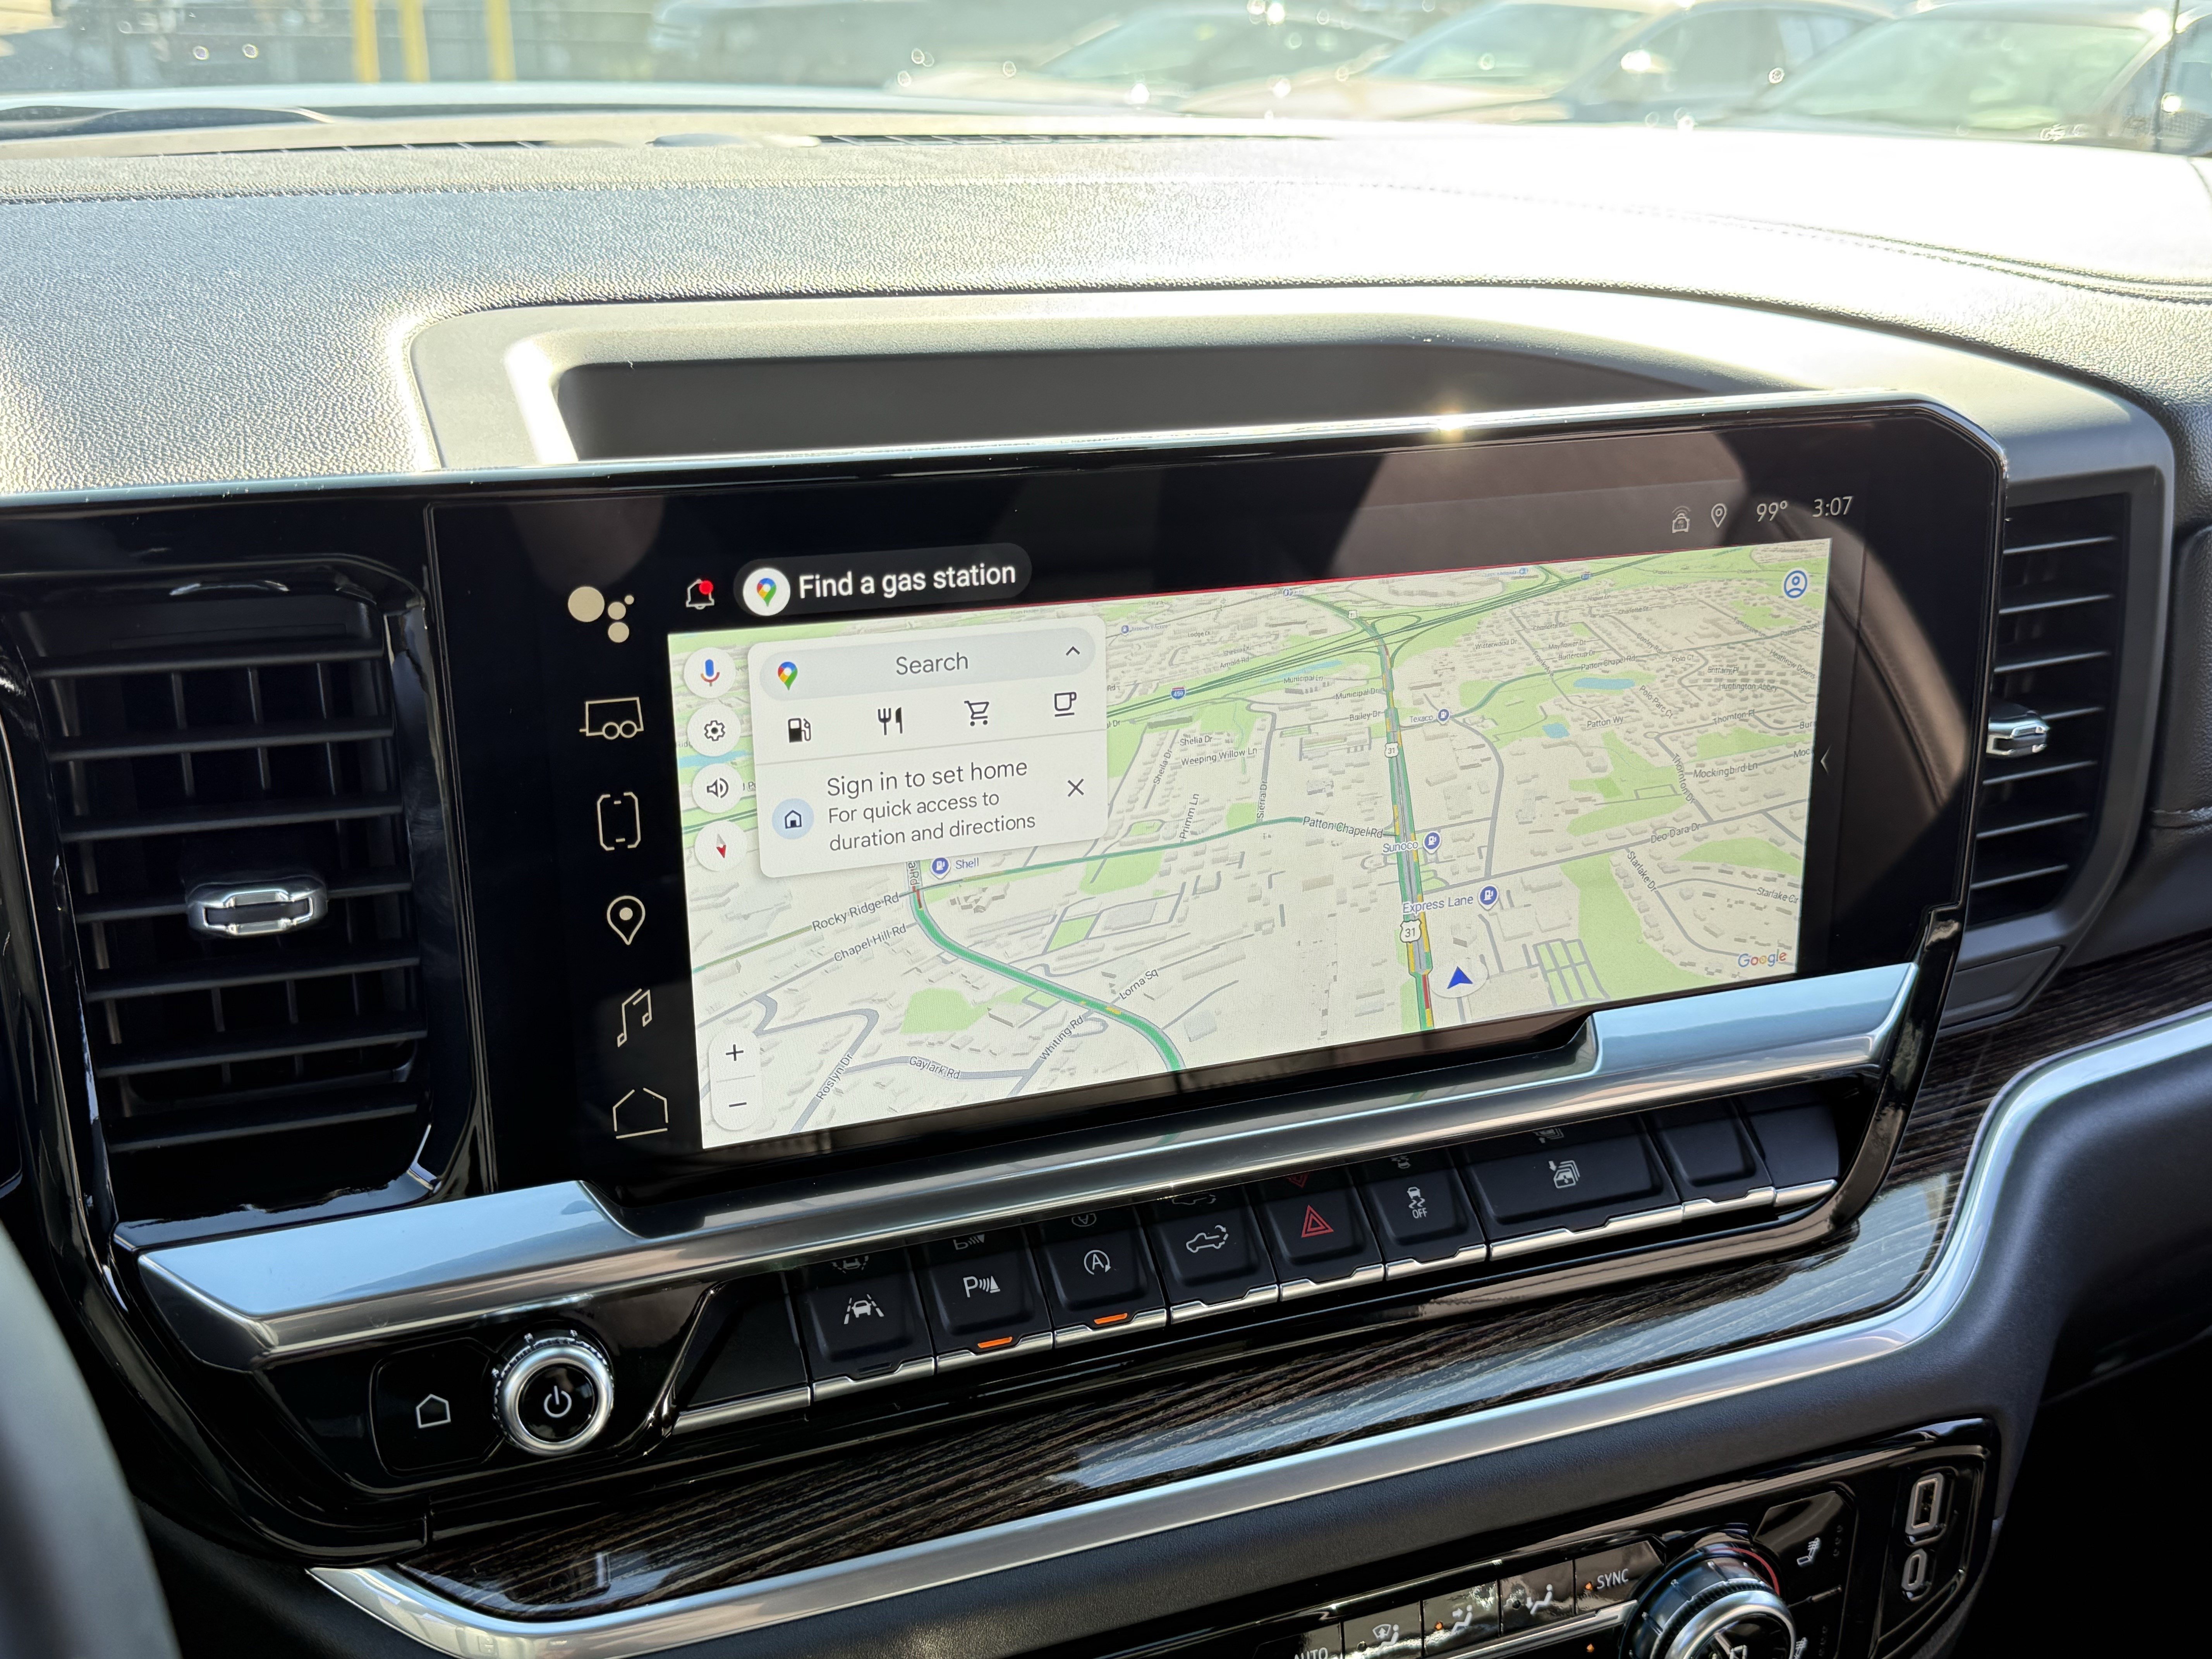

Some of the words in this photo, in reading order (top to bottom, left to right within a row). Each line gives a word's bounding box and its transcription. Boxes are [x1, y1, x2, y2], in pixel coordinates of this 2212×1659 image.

[1757, 500, 1788, 522] 99°
[1812, 496, 1853, 518] 3:07
[799, 571, 853, 598] Find
[860, 576, 875, 594] a
[882, 572, 926, 598] gas
[933, 563, 1016, 589] station
[896, 652, 969, 675] Search
[1581, 662, 1603, 670] Patton
[1769, 649, 1796, 669] Heathrow
[1796, 664, 1816, 679] Downs
[1336, 688, 1369, 700] Municipal
[1719, 683, 1756, 693] Huntington
[1757, 683, 1778, 692] Abbey
[1638, 685, 1653, 701] Polo
[1651, 697, 1666, 713] Parc
[1665, 709, 1673, 719] Ct
[1349, 713, 1370, 721] Bailey
[1410, 714, 1433, 723] Texaco
[1587, 718, 1611, 728] Patton
[1612, 716, 1623, 725] Wy
[1713, 712, 1746, 725] Thornton
[1164, 749, 1173, 760] Dr
[1182, 754, 1217, 766] Weeping
[1219, 748, 1245, 760] Willow
[1248, 747, 1257, 755] Ln
[828, 776, 872, 799] Sign
[880, 772, 897, 791] in
[905, 772, 925, 788] to
[933, 766, 964, 785] set
[971, 762, 1028, 781] home
[1673, 753, 1689, 794] Thornton
[1685, 793, 1696, 804] Dr
[1693, 764, 1745, 779] Mockingbird
[1748, 763, 1758, 771] Ln
[1260, 780, 1267, 792] Dr
[829, 807, 857, 824] For
[863, 799, 912, 823] quick
[917, 795, 977, 813] access
[982, 792, 999, 806] to
[1180, 809, 1195, 839] Primm
[1190, 793, 1200, 806] Ln
[1257, 792, 1267, 819] Sierra
[830, 829, 905, 851] duration
[911, 822, 943, 842] and
[949, 815, 1036, 837] directions
[1302, 816, 1335, 830] Patton
[1336, 822, 1369, 837] Chapel
[1370, 828, 1384, 839] Rd
[1650, 833, 1667, 844] Deo
[1669, 826, 1690, 838] Dara
[1690, 822, 1701, 832] Dr
[1383, 841, 1419, 853] Sunoco
[955, 857, 979, 869] Shell
[1627, 851, 1650, 883] Starlake
[1647, 879, 1658, 893] Dr
[909, 871, 921, 886] Rd
[1403, 899, 1445, 914] Express
[1448, 896, 1474, 908] Lane
[1757, 887, 1788, 902] Starlake
[812, 910, 848, 931] Rocky
[849, 900, 882, 917] Ridge
[884, 892, 900, 906] Rd
[834, 941, 871, 961] Chapel
[872, 930, 890, 944] Hill
[891, 923, 907, 936] Rd
[1405, 927, 1415, 938] 31
[1738, 949, 1788, 968] Google
[1119, 978, 1146, 1000] Lorna
[1144, 968, 1159, 983] Sq
[1039, 1027, 1072, 1060] Whiting
[1070, 1015, 1084, 1031] Rd
[816, 1065, 845, 1100] Roslyn
[840, 1053, 853, 1067] Dr
[909, 1056, 945, 1075] Gaylark
[946, 1068, 961, 1080] Rd
[1412, 1207, 1427, 1219] OFF
[1597, 1568, 1630, 1590] SYNC
